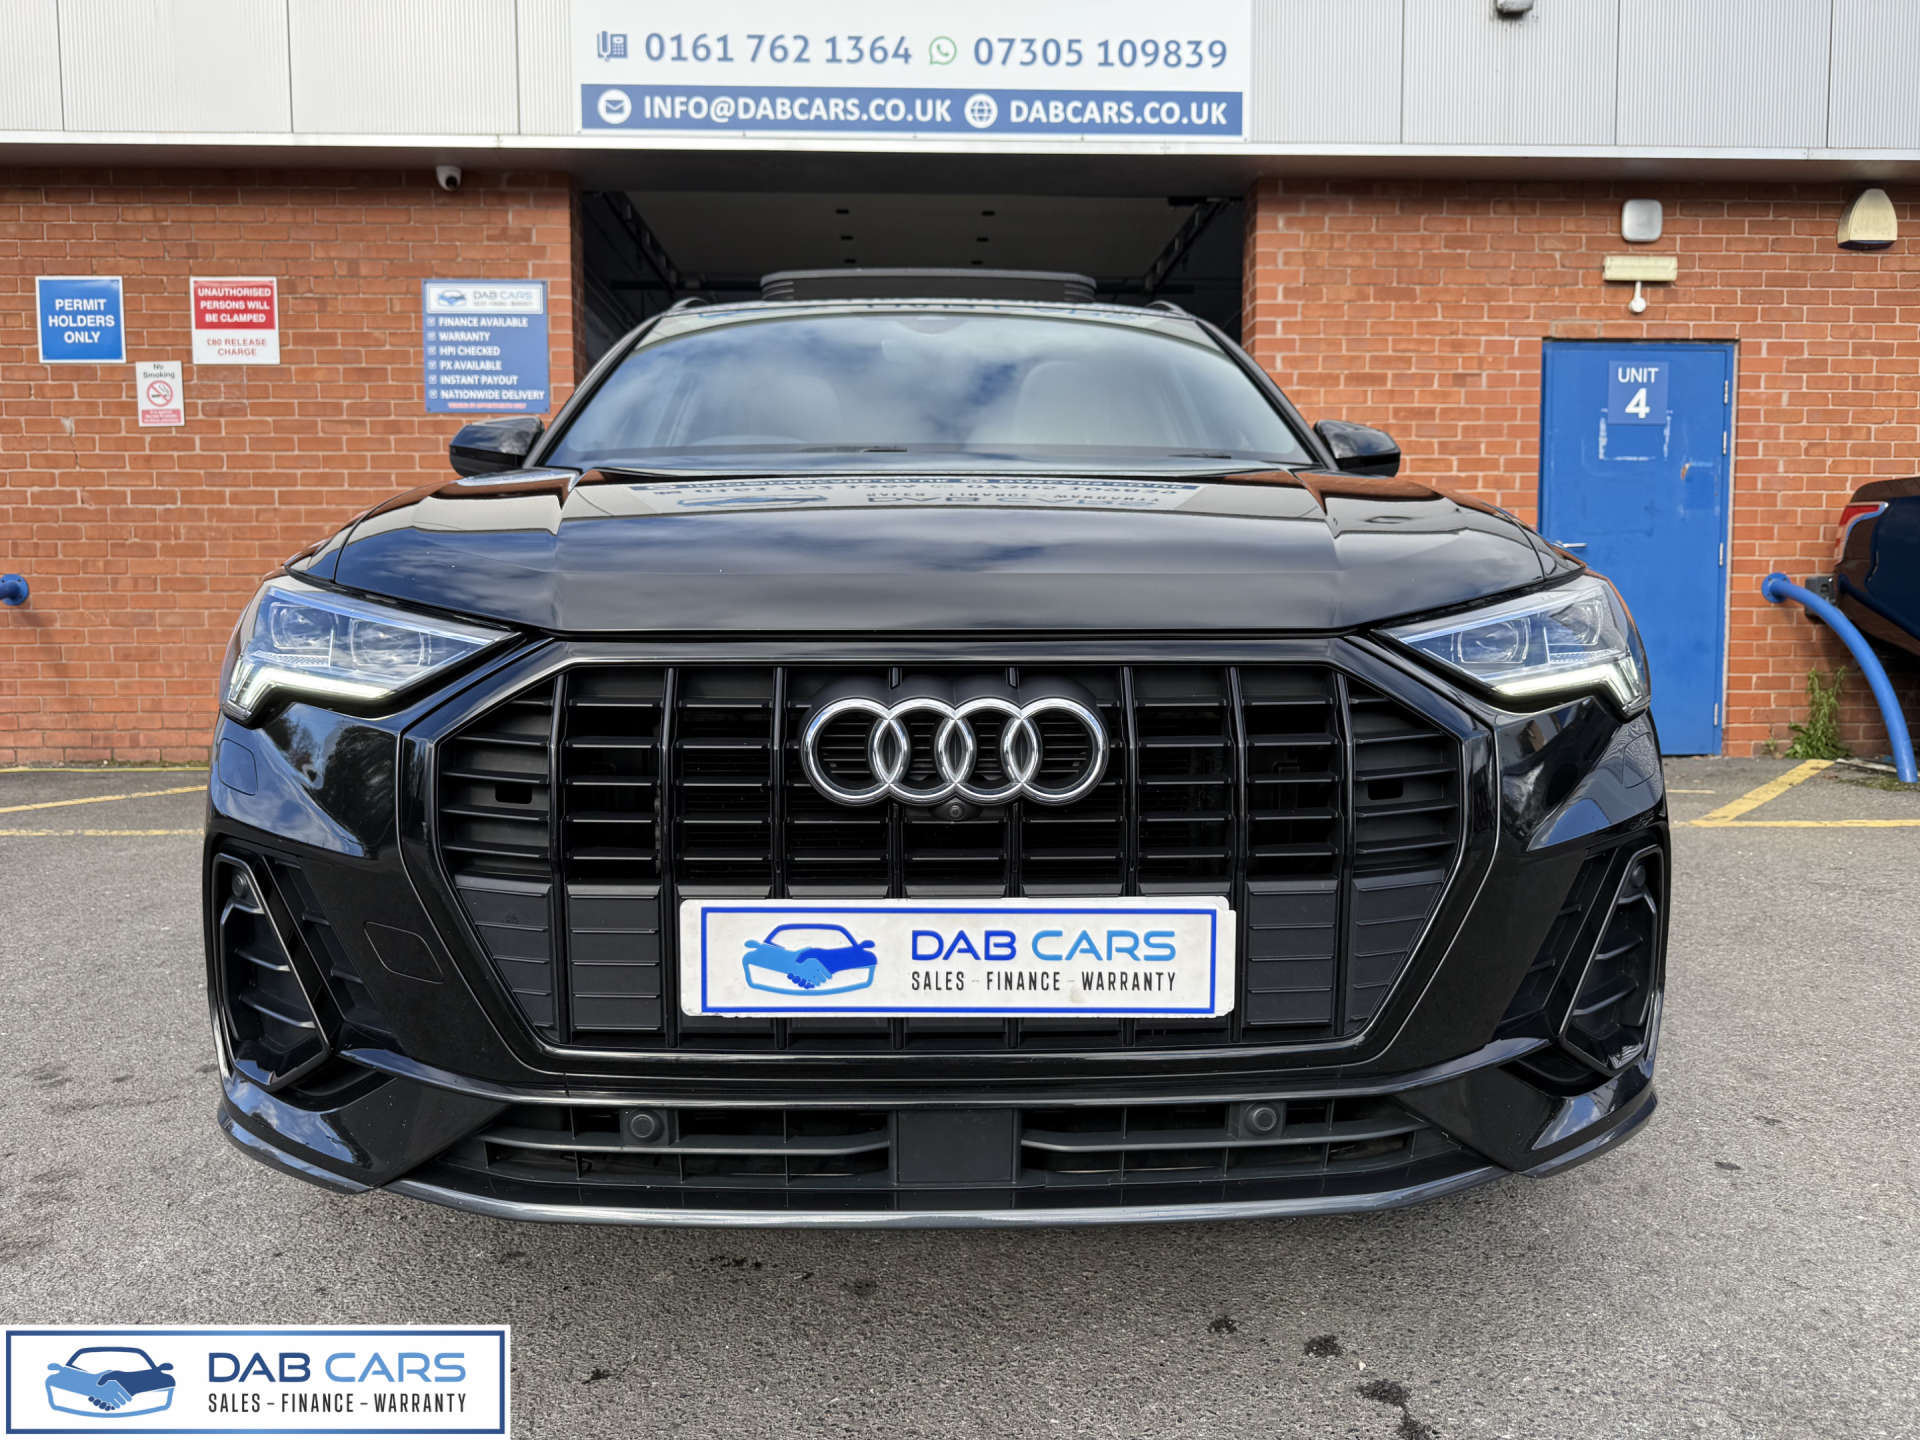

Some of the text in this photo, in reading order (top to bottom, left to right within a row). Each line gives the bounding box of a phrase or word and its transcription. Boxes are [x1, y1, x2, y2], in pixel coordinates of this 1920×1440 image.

[645, 33, 913, 65] 0161 762 1364
[973, 36, 1228, 69] 07305 109839
[643, 94, 952, 123] INFO@DABCARS.CO.UK
[1010, 99, 1227, 126] DABCARS.CO.UK
[198, 287, 272, 297] UNAUTHORISED
[55, 298, 107, 311] PERMIT
[200, 300, 270, 310] PERSONS WILL
[48, 315, 115, 328] HOLDERS
[205, 313, 267, 323] BE CLAMPED
[438, 317, 529, 328] FINANCE AVAILABLE
[64, 331, 101, 344] ONLY
[224, 337, 267, 347] RELEASE
[438, 331, 491, 342] WARRANTY
[217, 347, 257, 357] CHARGE
[439, 346, 501, 356] HPI CHECKED
[440, 360, 503, 371] PX AVAILABLE
[440, 375, 519, 385] INSTANT PAYOUT
[1617, 367, 1660, 384] UNIT
[440, 389, 545, 401] NATIONWIDE DELIVERY
[1624, 387, 1651, 419] 4
[912, 929, 1177, 962] DAB CARS
[911, 971, 965, 991] SALES
[987, 971, 1061, 991] FINANCE
[1081, 971, 1176, 991] WARRANTY
